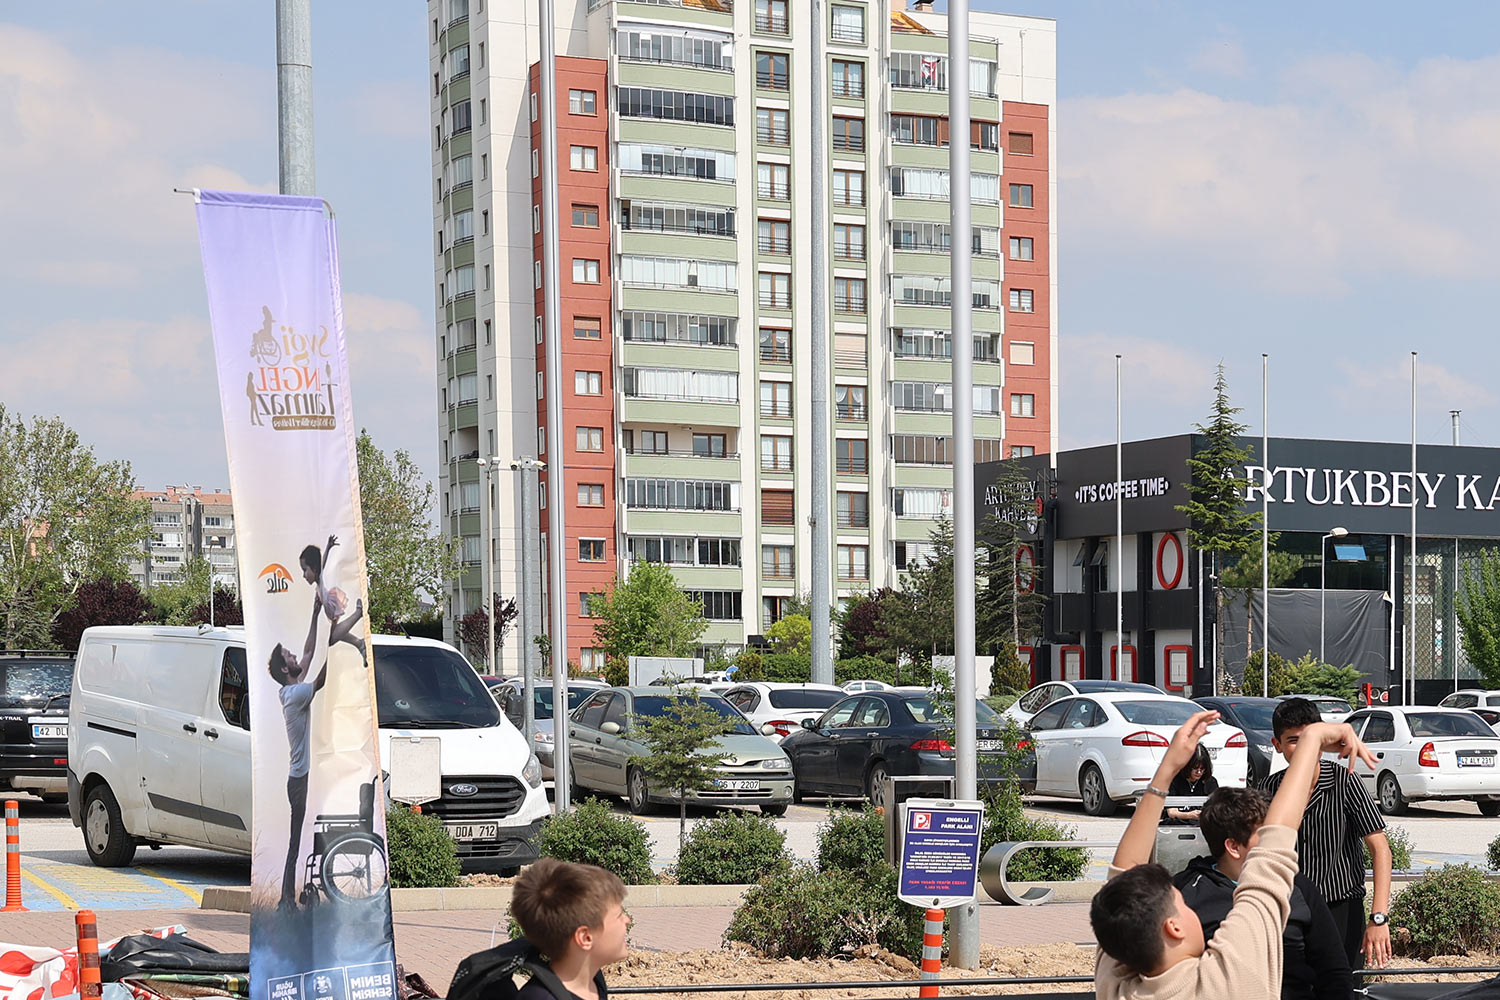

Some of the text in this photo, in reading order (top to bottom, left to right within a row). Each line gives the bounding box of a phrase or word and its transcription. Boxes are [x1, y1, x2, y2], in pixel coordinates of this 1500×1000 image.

[1079, 477, 1166, 503] IT'S COFFEE TIME
[40, 726, 50, 736] 42
[455, 785, 473, 794] Ford
[479, 825, 496, 837] 712
